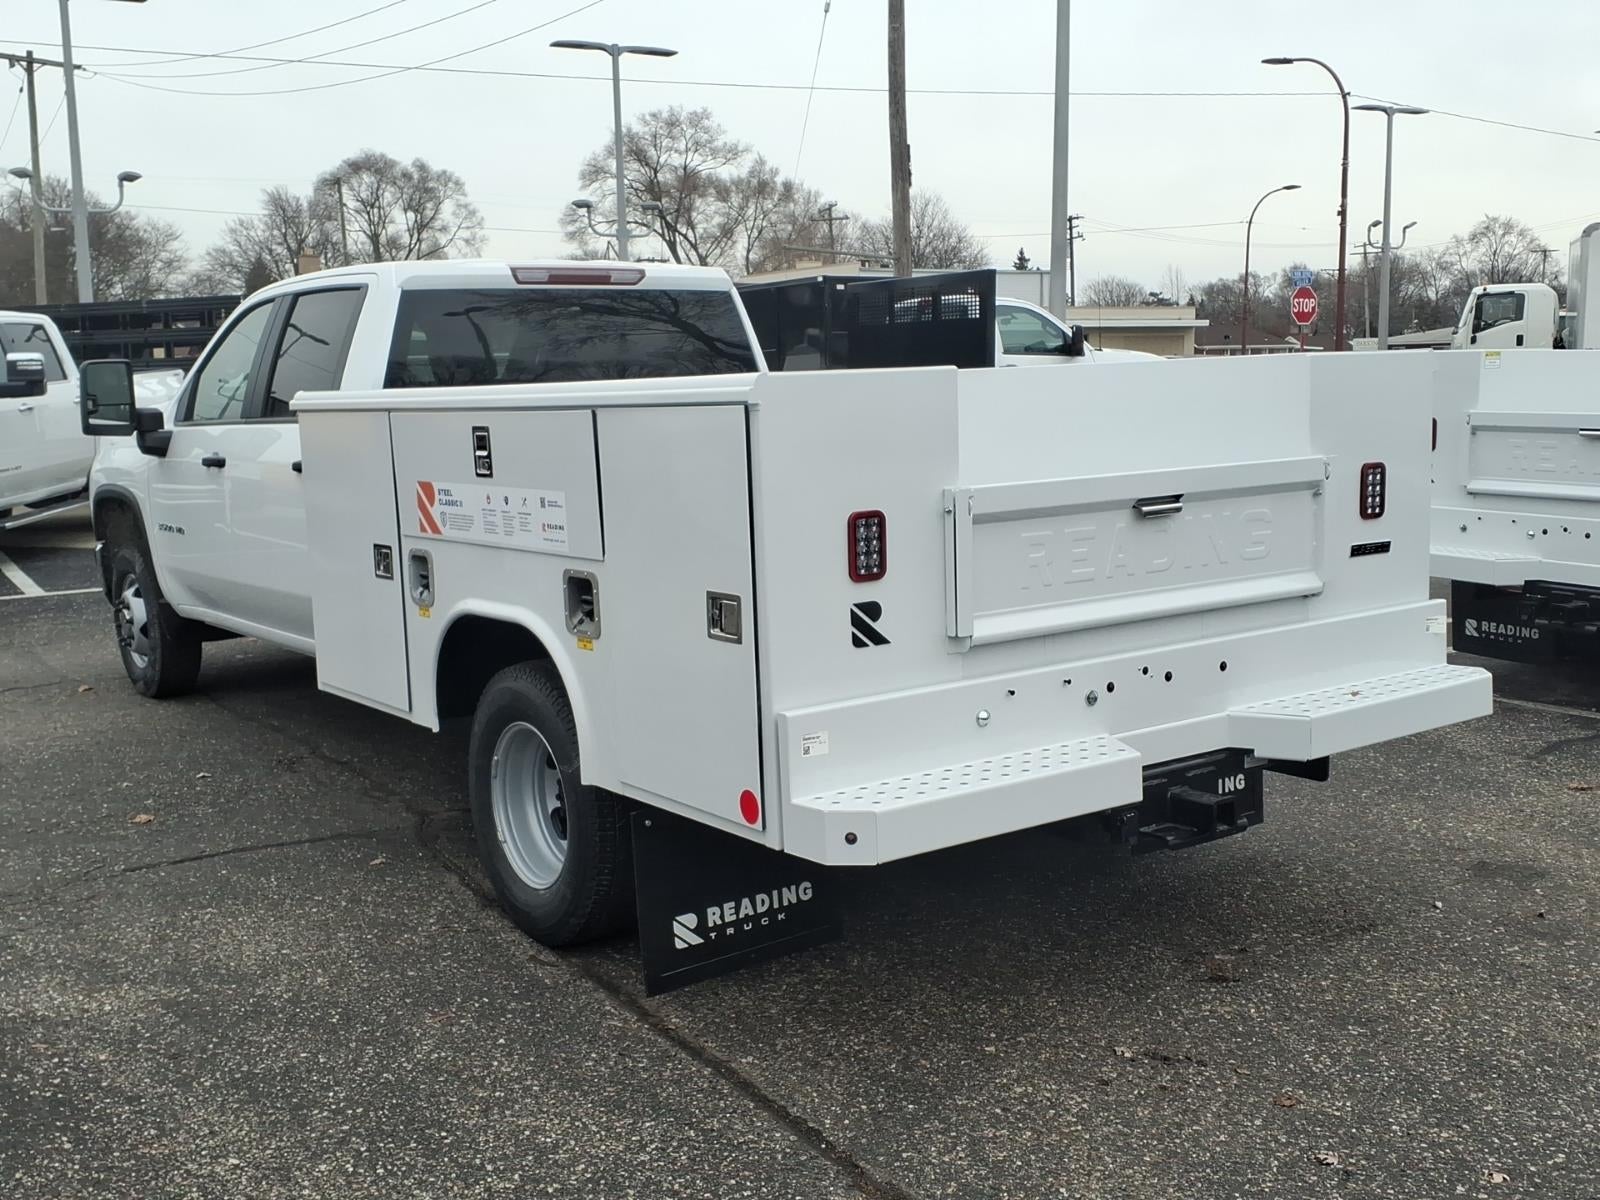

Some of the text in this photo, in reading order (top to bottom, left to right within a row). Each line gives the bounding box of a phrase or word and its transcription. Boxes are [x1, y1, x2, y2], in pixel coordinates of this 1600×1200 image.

[1293, 298, 1316, 313] STOP
[437, 487, 453, 497] STEEL
[438, 498, 459, 508] CLASSIC
[1019, 507, 1273, 590] READING
[1481, 621, 1540, 640] READING
[1481, 633, 1522, 643] TRUCK
[706, 881, 813, 928] READING
[709, 912, 786, 940] TRUCK
